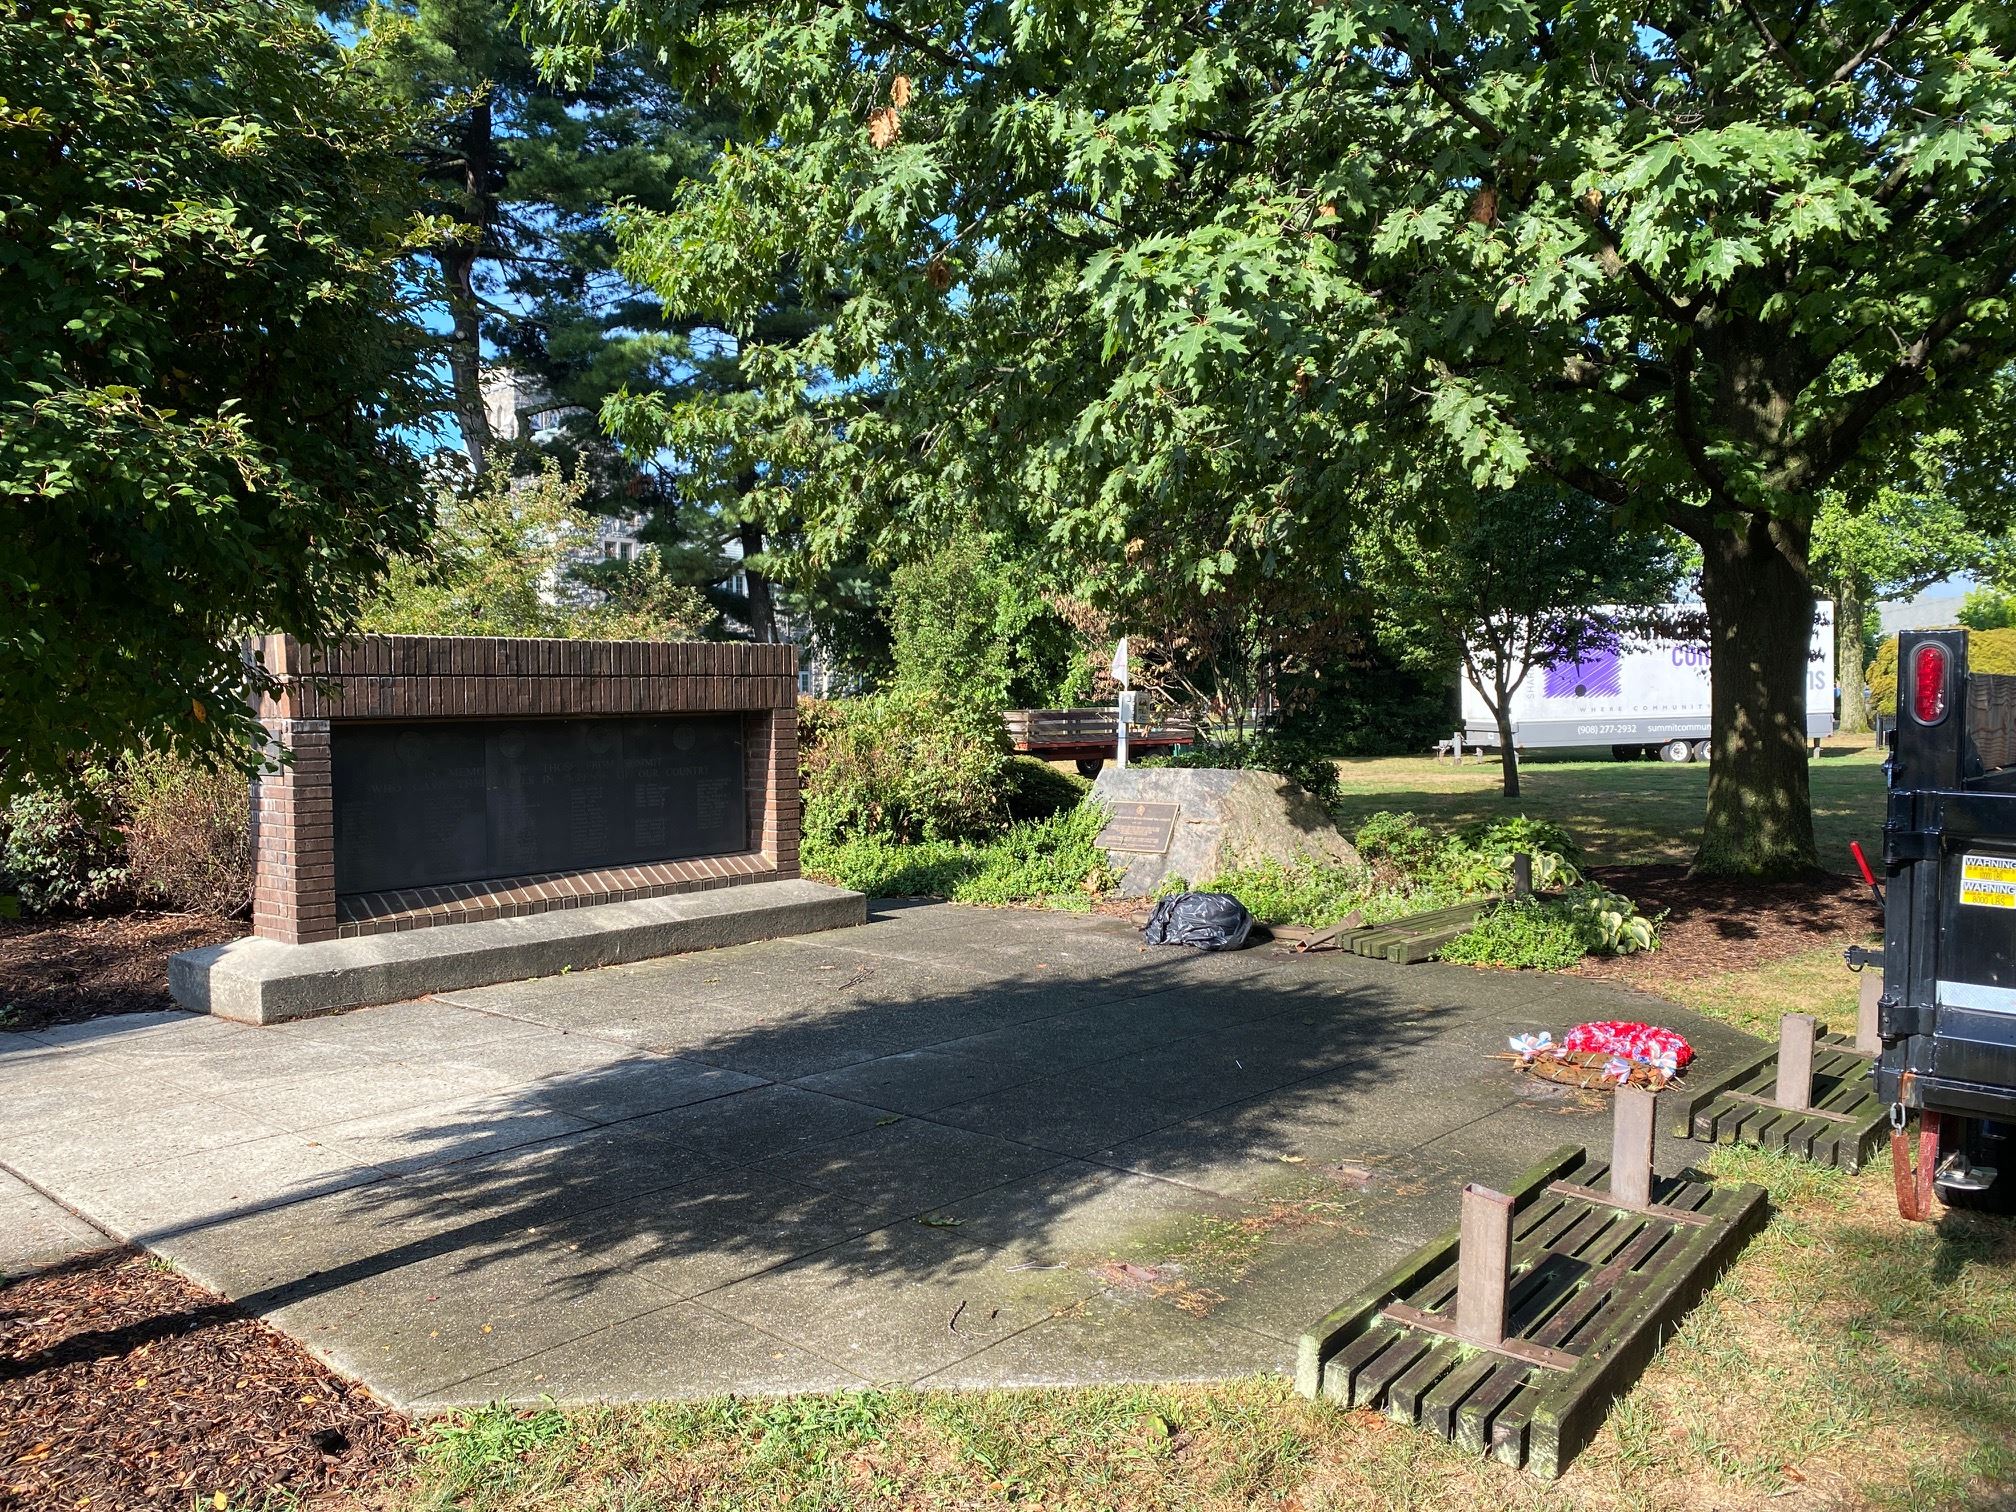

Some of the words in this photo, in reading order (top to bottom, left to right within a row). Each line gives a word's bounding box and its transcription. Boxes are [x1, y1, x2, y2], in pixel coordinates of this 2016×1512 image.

[1577, 724, 1599, 734] (908)
[1600, 723, 1637, 734] 277-2932
[1966, 858, 2016, 869] WARNING
[1963, 882, 2016, 894] WARNING
